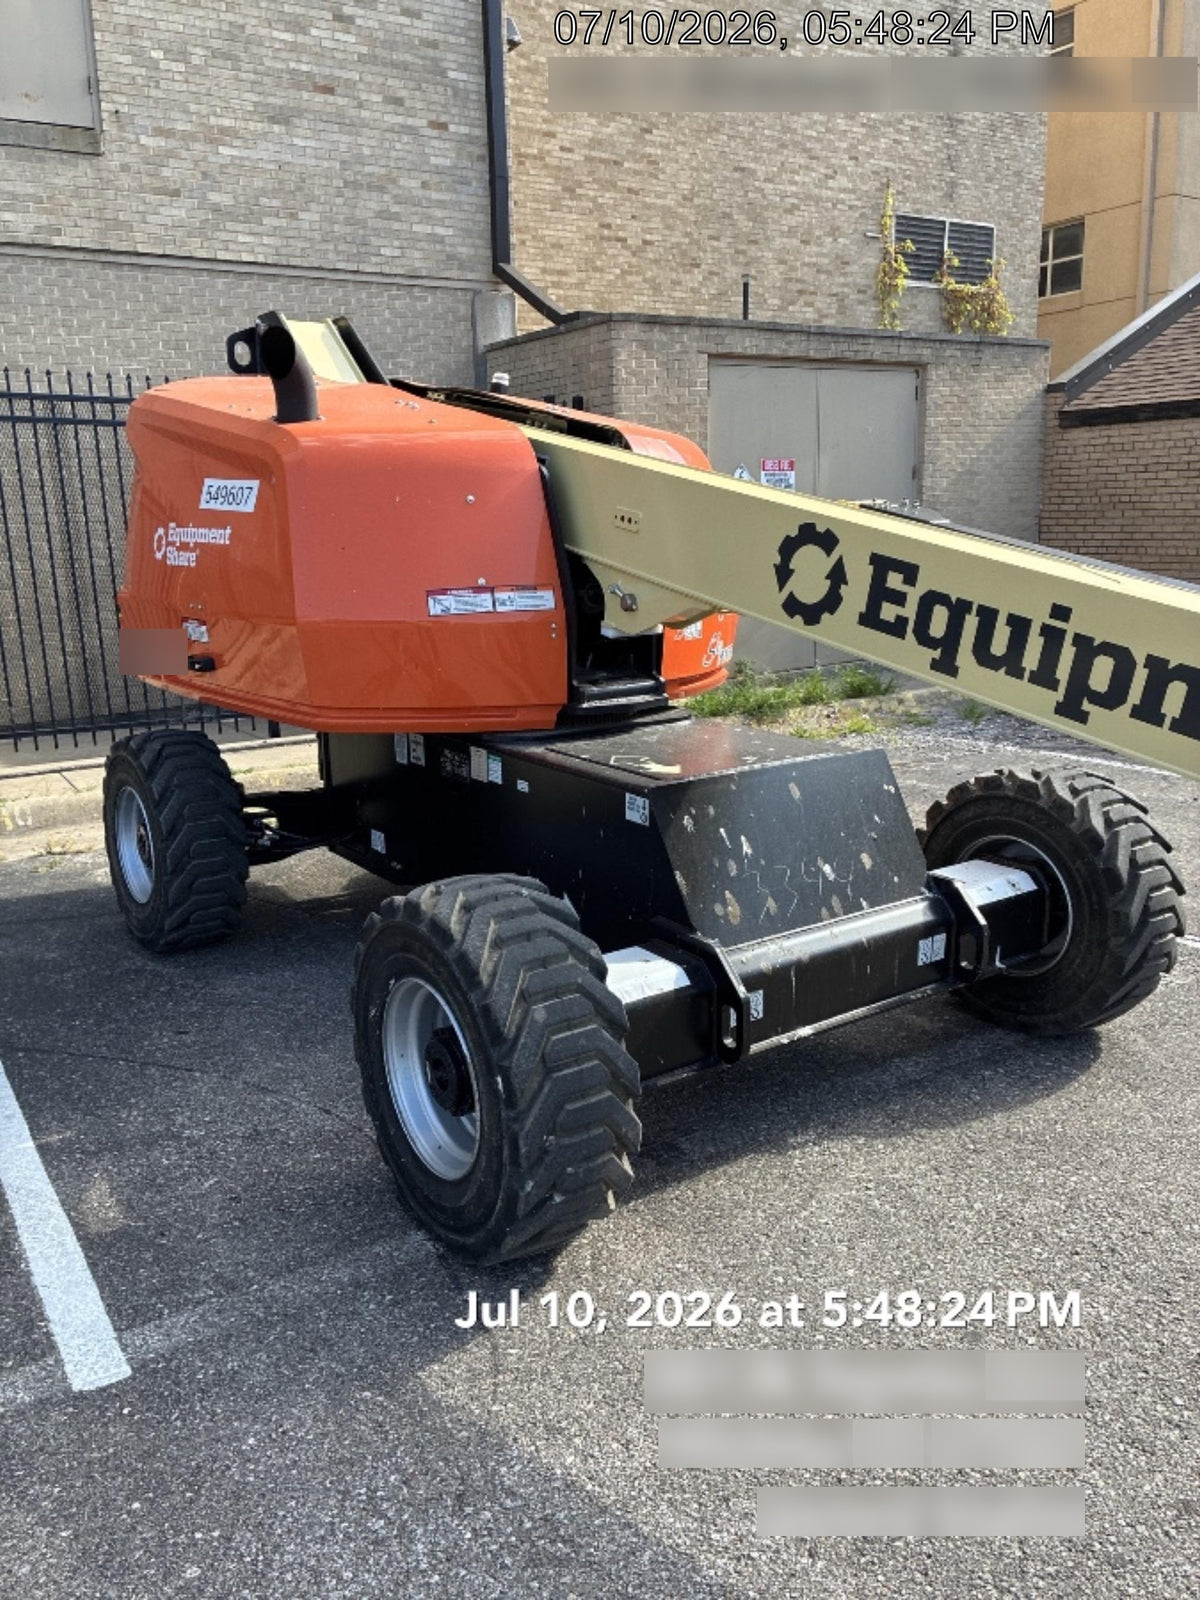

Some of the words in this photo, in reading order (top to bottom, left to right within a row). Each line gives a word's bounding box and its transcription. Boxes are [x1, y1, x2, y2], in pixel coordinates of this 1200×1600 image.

[205, 485, 253, 506] 549607
[168, 522, 231, 547] Equipment
[166, 546, 196, 567] Share
